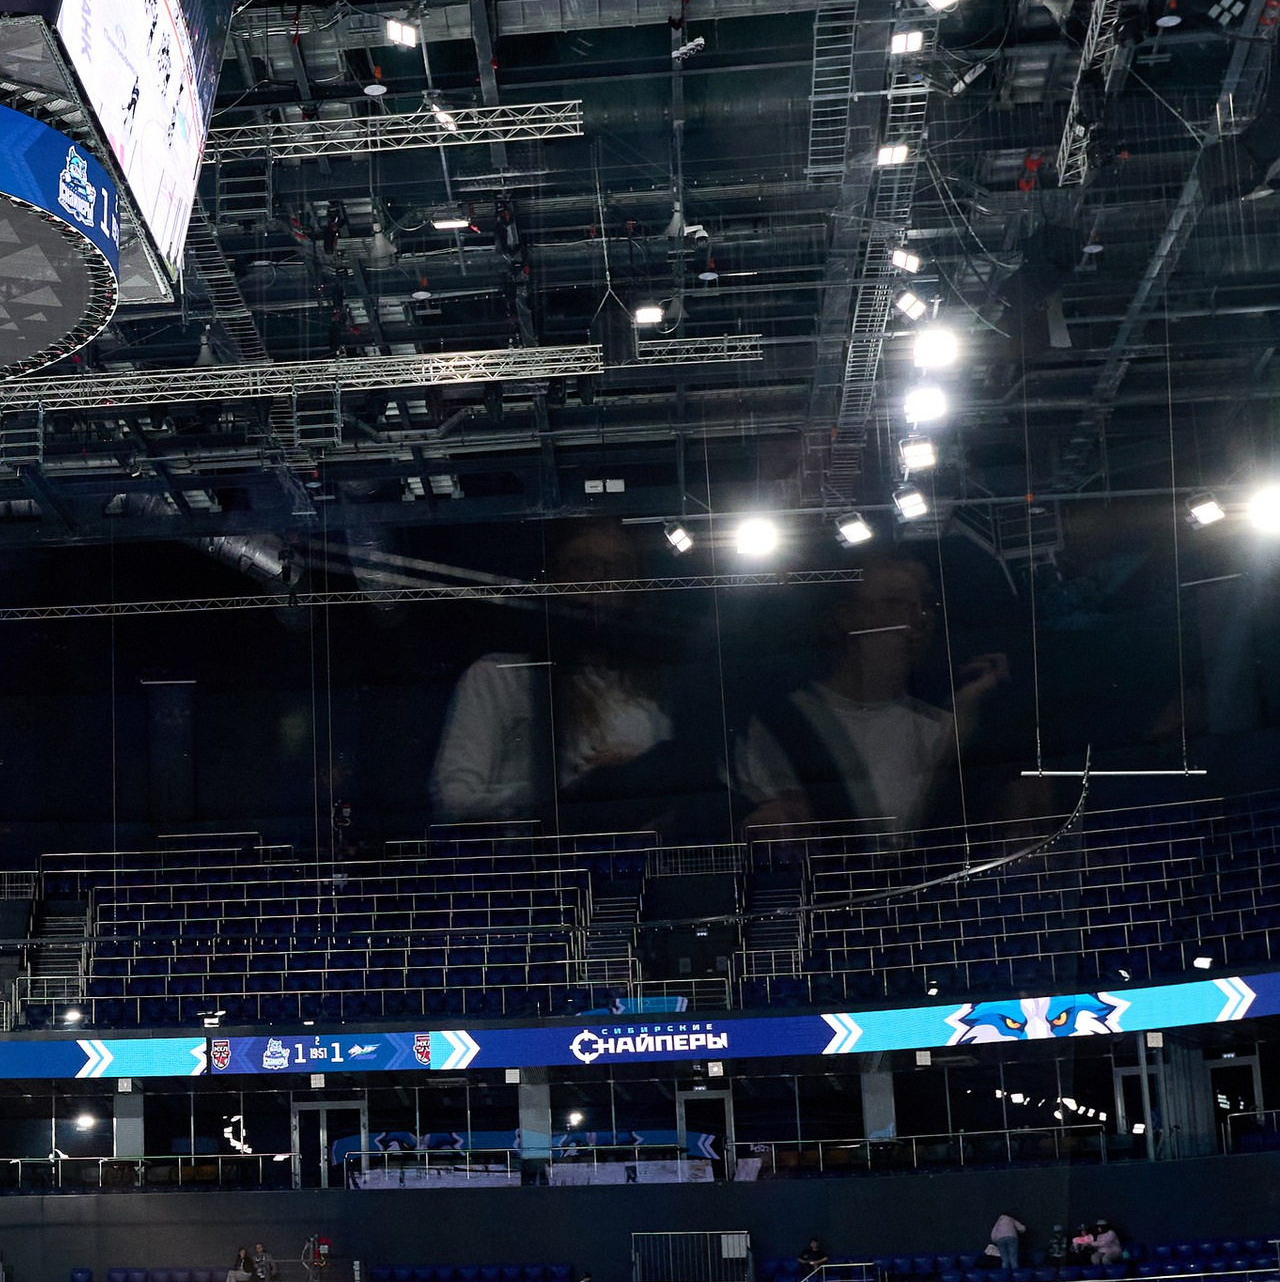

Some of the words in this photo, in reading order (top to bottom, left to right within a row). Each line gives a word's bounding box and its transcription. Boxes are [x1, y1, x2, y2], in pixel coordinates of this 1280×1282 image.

[601, 1023, 713, 1035] СИБИРСКИЕ
[294, 1043, 306, 1063] 1
[331, 1042, 344, 1062] 1
[569, 1029, 728, 1064] СНАЙПЕРЫ
